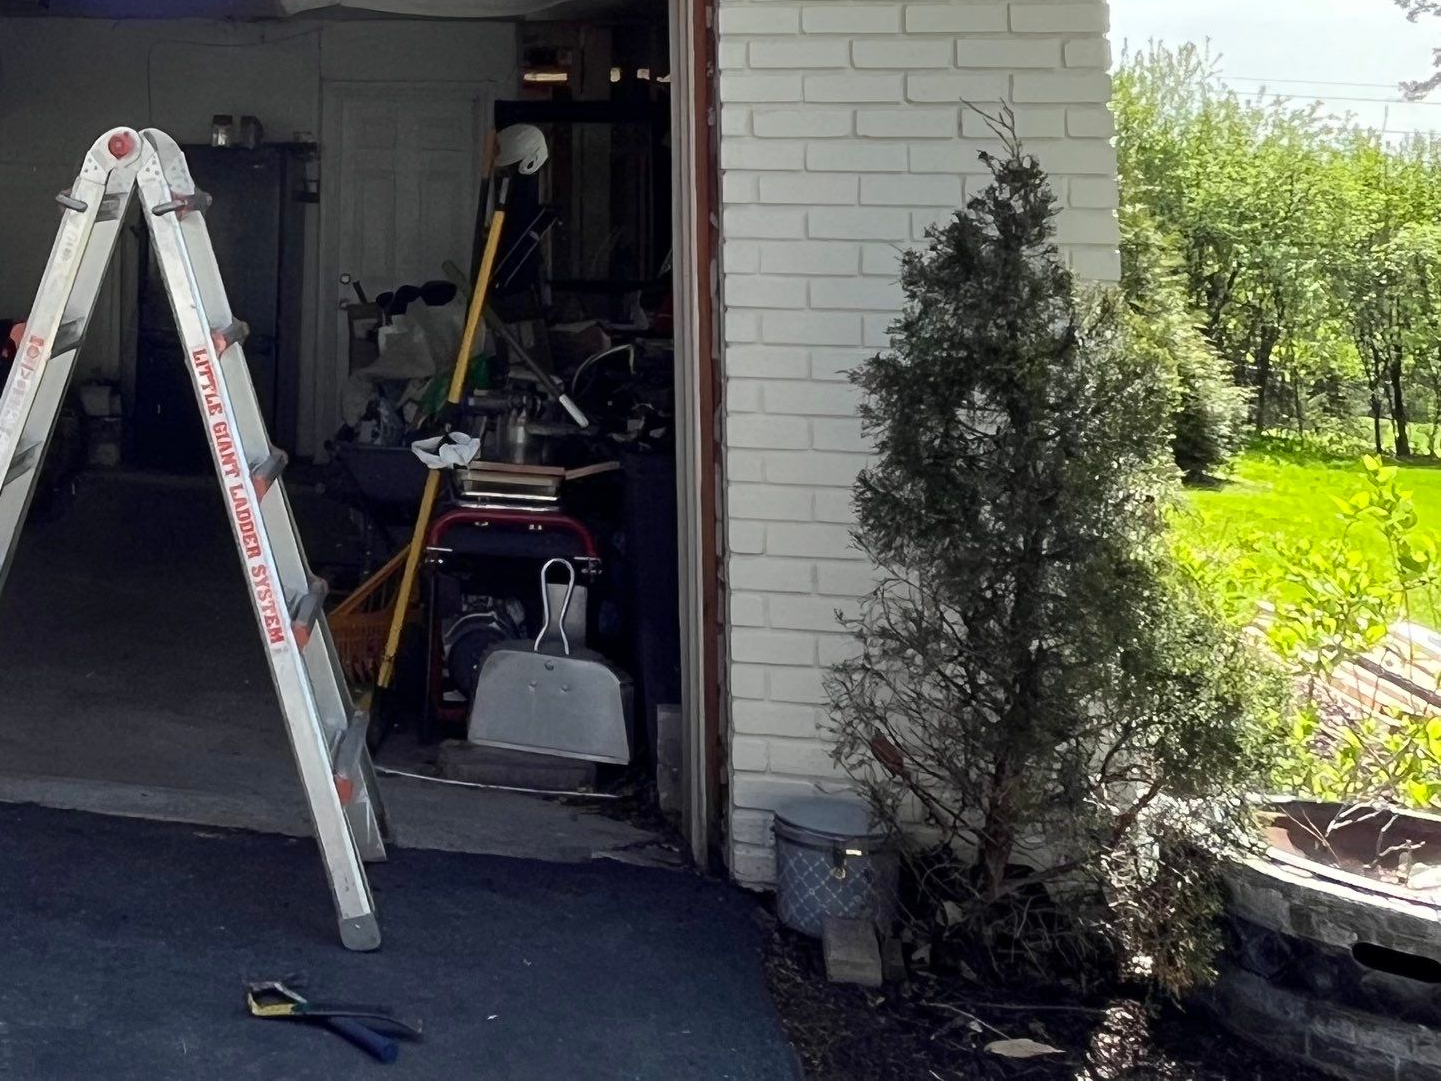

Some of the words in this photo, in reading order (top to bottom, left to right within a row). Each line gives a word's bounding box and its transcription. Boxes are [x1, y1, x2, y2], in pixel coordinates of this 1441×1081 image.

[192, 348, 223, 416] LITTLE
[212, 421, 241, 478] GIANT
[229, 484, 261, 558] LADDER
[251, 564, 284, 643] SYSTEM
